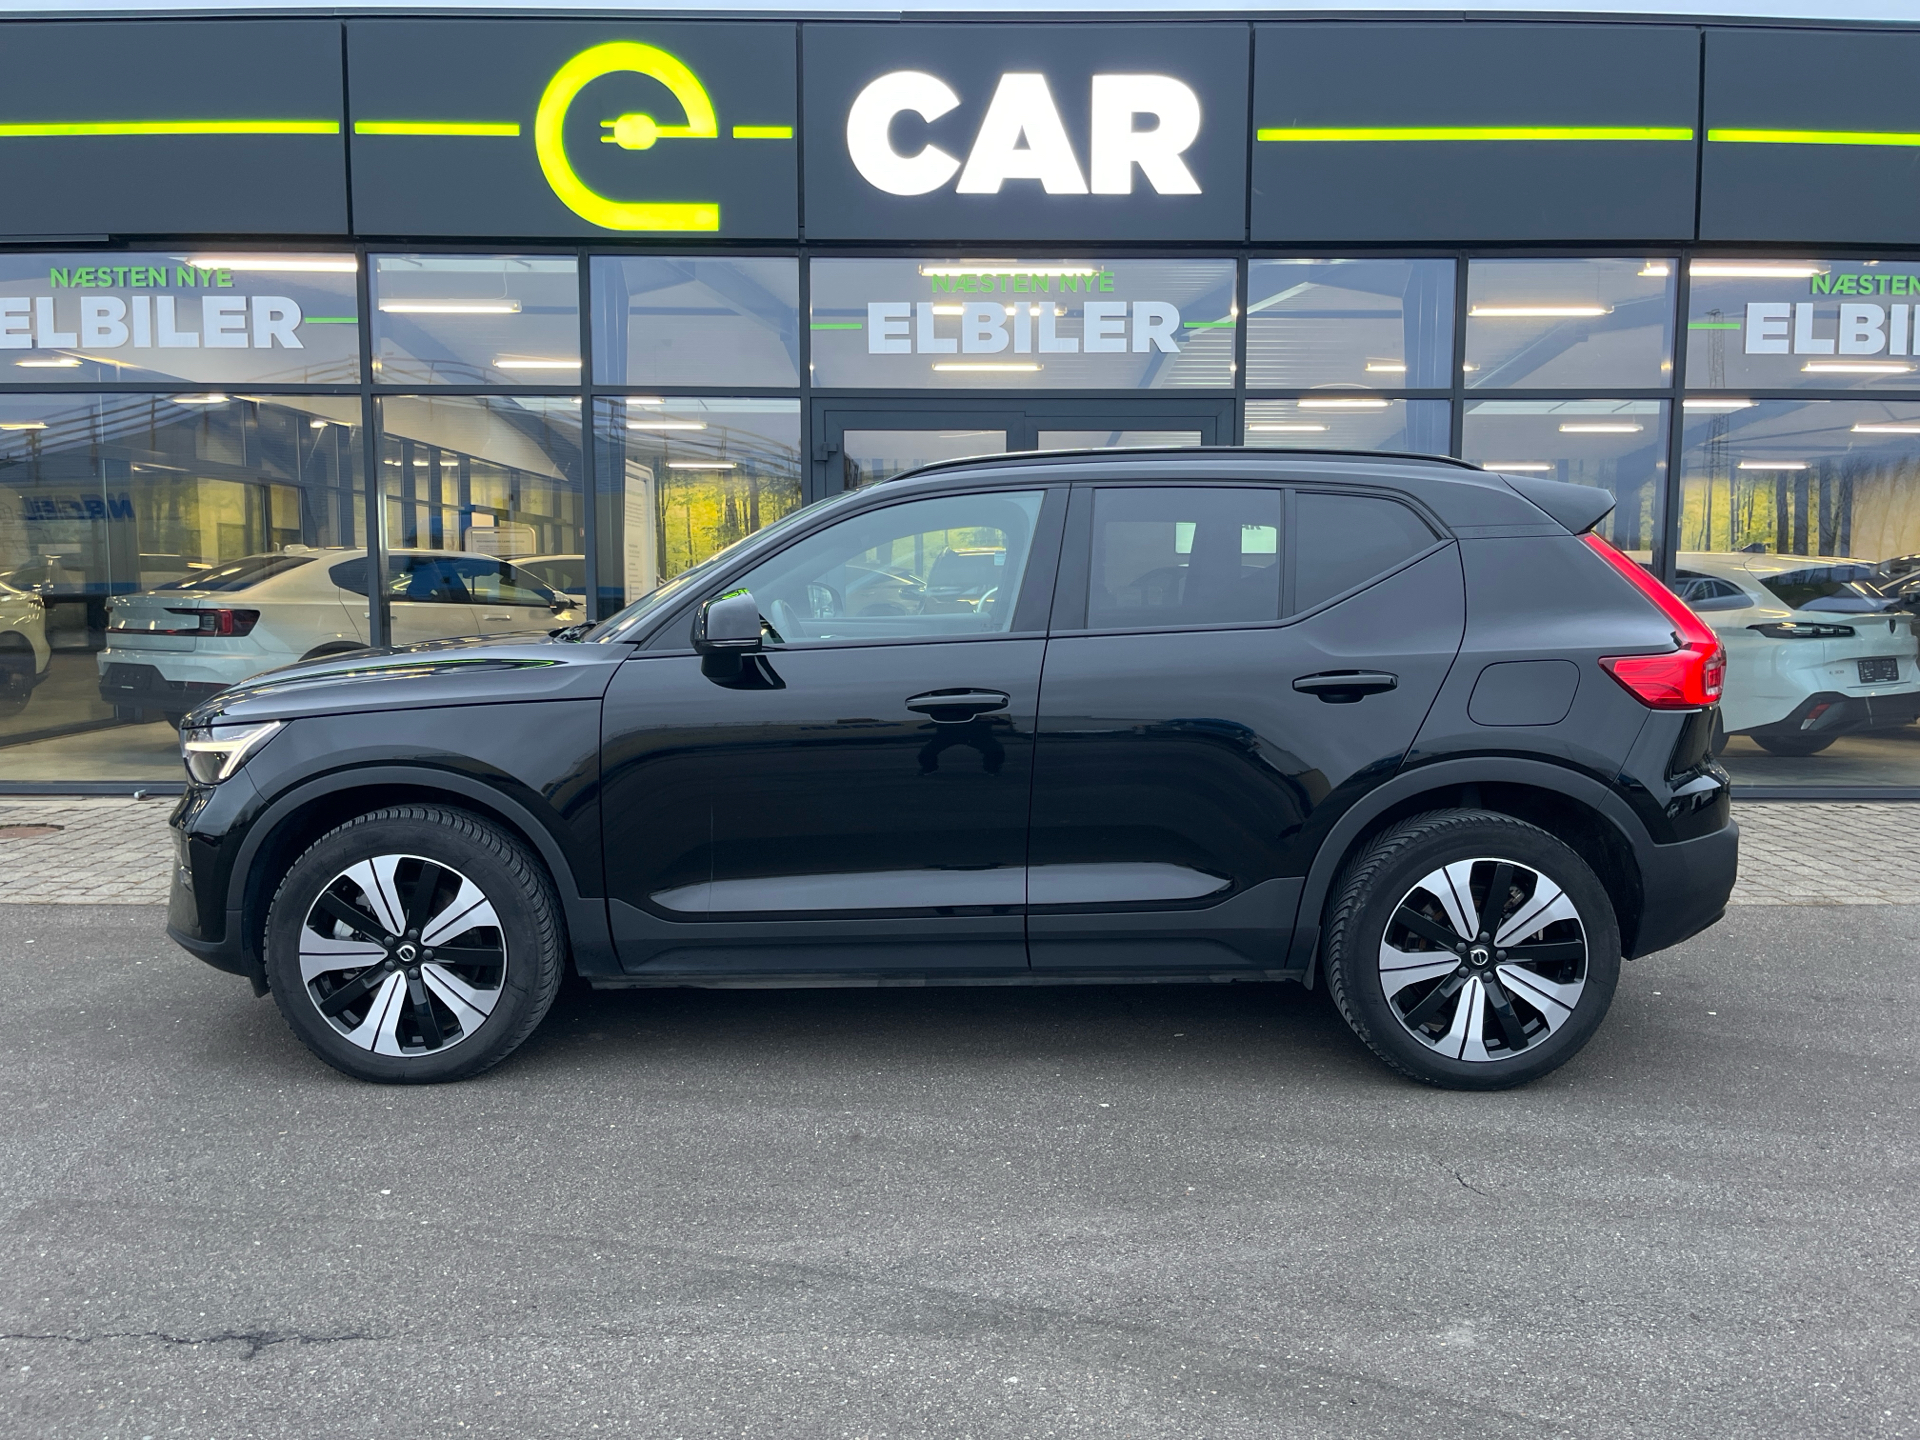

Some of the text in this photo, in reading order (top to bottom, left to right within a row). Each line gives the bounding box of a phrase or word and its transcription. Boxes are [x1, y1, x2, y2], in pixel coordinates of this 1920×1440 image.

[846, 71, 1202, 196] CAR
[50, 266, 234, 288] NÆSTEN NYE
[931, 271, 1115, 294] NÆSTEN NYE
[867, 300, 1181, 355] ELBILER
[1745, 302, 1920, 356] ELBI
